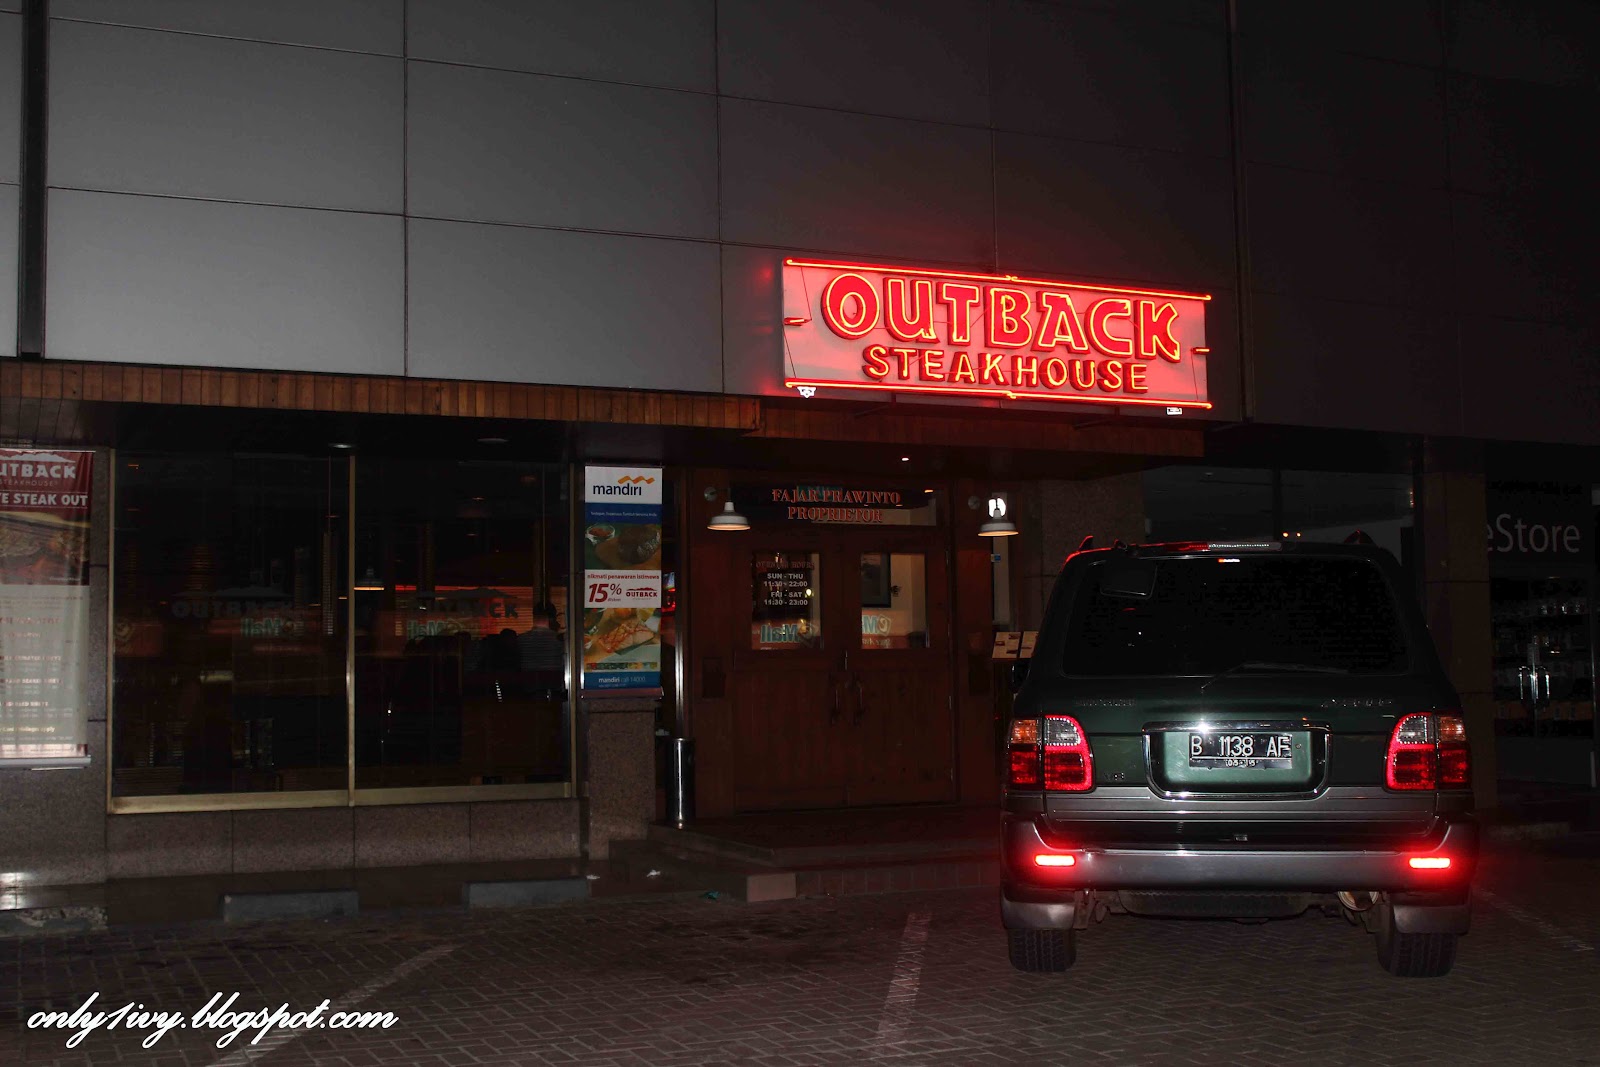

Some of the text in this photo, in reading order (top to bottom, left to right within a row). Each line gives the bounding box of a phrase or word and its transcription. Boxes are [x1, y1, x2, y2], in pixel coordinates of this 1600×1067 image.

[821, 273, 1182, 363] OUTBACK
[862, 344, 1149, 394] STEAKHOUSE
[0, 463, 76, 479] UTBACK
[0, 479, 55, 487] TEAKHOUSE
[593, 483, 642, 496] mandiri
[13, 493, 57, 505] STEAK
[61, 494, 88, 506] OUT
[771, 488, 901, 505] FAJAR PRAWINTO
[787, 506, 882, 523] PROPRIETOR
[588, 583, 622, 603] 15%
[1191, 735, 1202, 756] B
[1219, 735, 1254, 757] 1138
